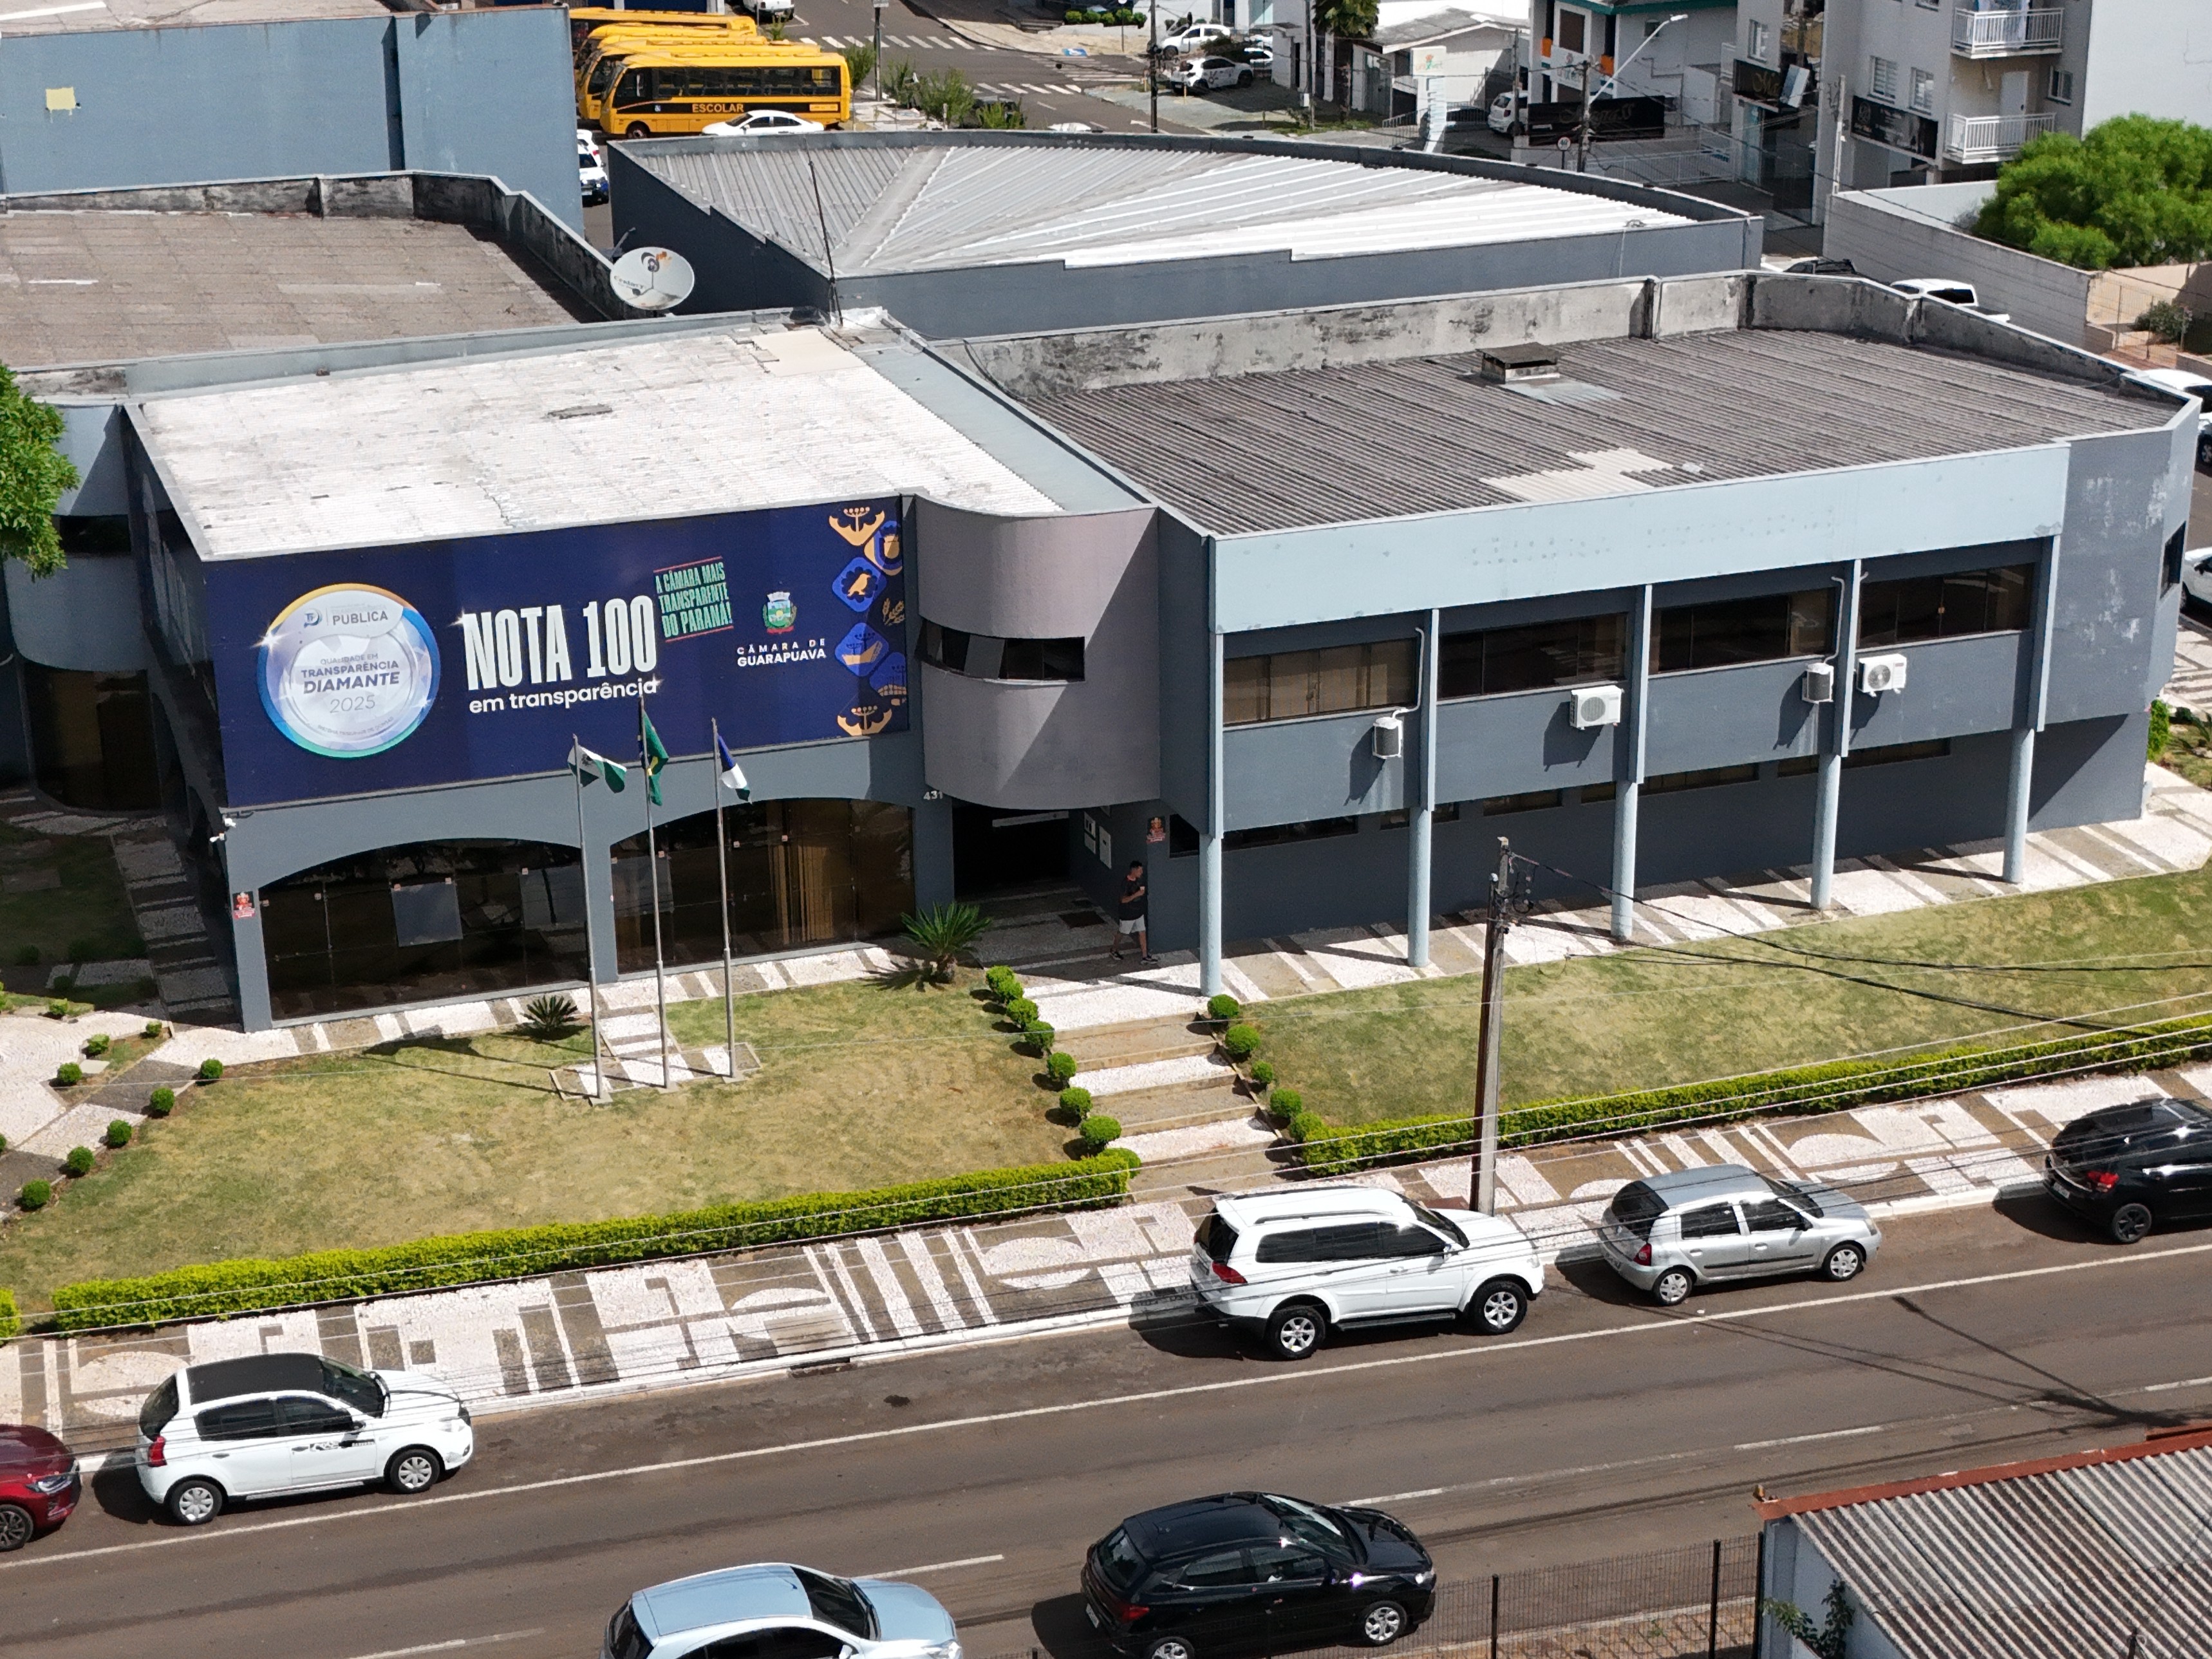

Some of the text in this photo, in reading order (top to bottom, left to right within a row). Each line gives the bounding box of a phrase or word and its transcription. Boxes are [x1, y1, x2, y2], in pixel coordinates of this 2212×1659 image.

[692, 104, 744, 113] ESCOLAR
[655, 562, 726, 594] A CÂMARA MAIS
[658, 581, 729, 614] TRANSPARENTE
[661, 601, 733, 638] DO PARANÁ!
[463, 595, 657, 691] NOTA 100
[736, 638, 825, 655] CÂMARA DE
[737, 648, 827, 667] GUARAPUAVA
[301, 661, 399, 678] TRANSPARÊNCIA
[303, 671, 400, 694] DIAMANTE
[330, 695, 375, 713] 2025
[469, 679, 657, 713] em transparência
[923, 791, 943, 800] 431
